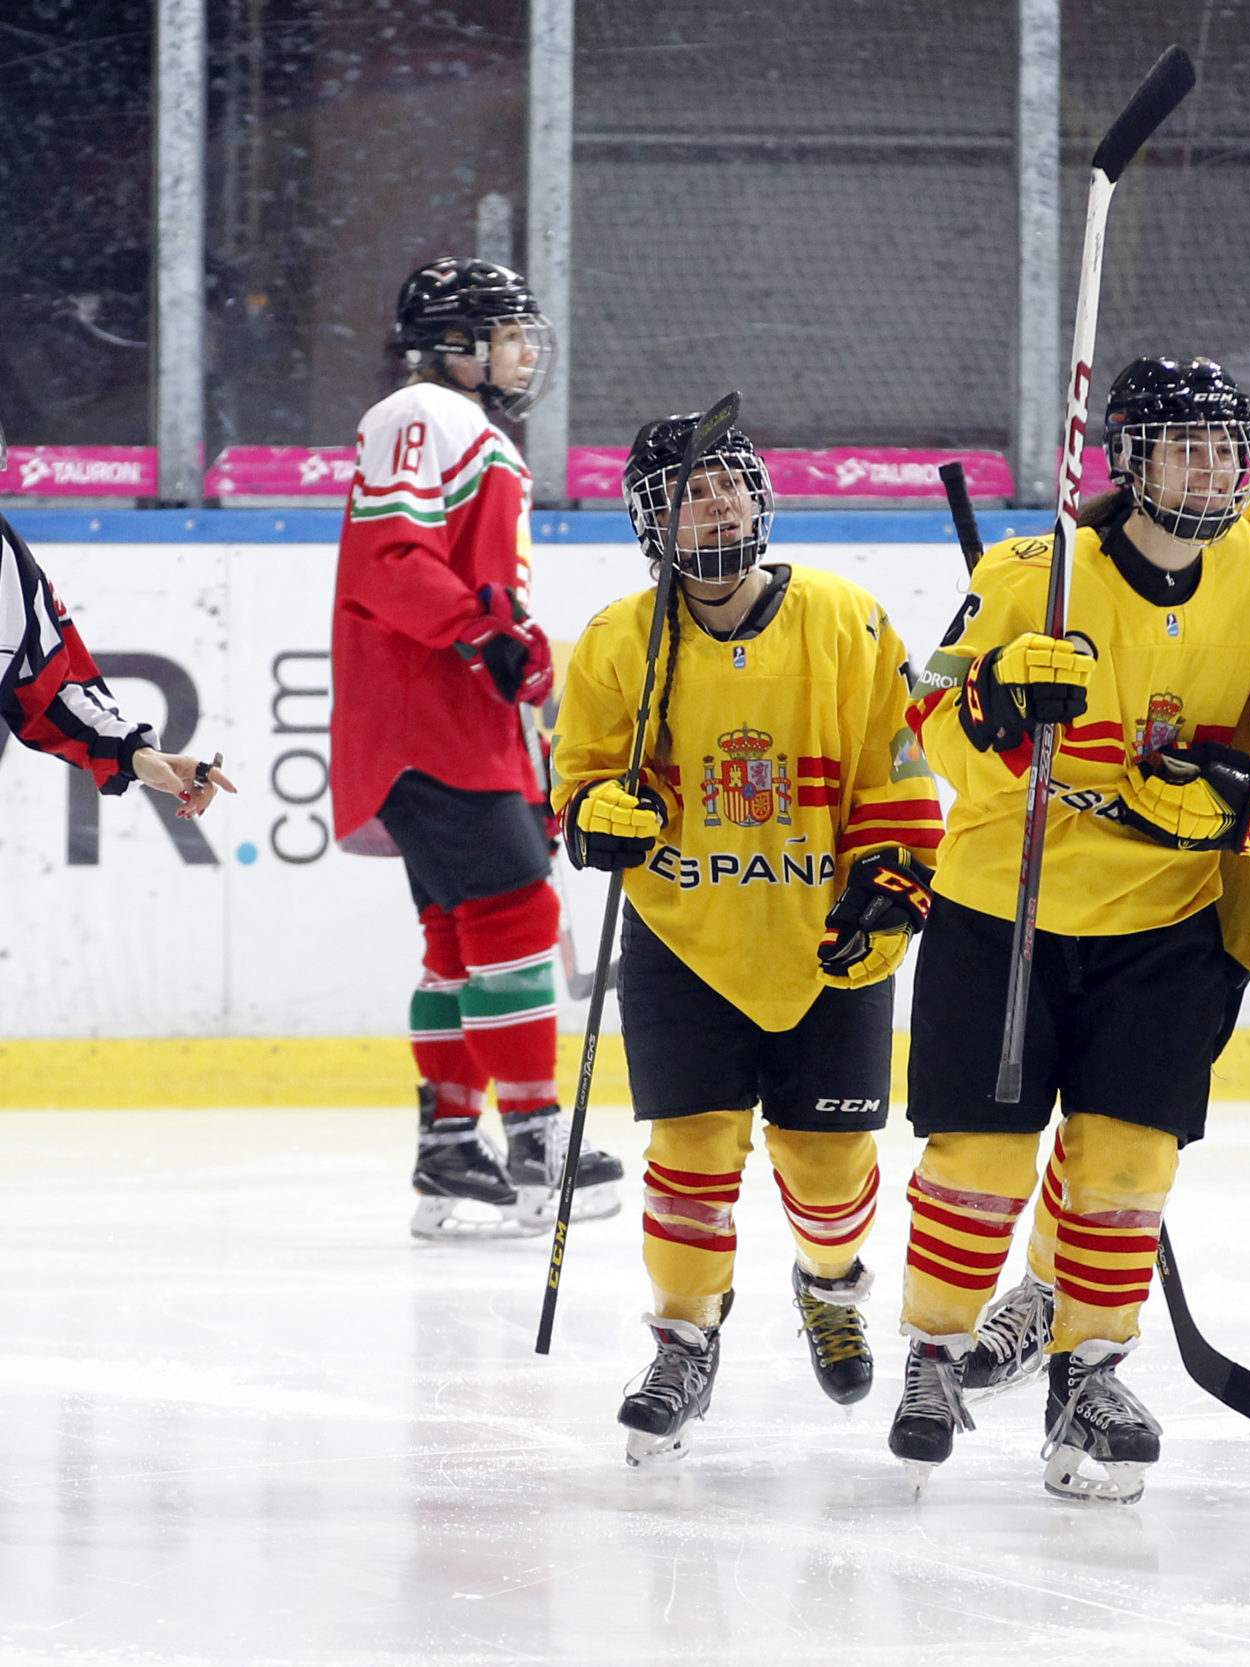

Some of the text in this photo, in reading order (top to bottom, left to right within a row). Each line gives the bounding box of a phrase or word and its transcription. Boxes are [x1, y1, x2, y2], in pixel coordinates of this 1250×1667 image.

[1193, 393, 1233, 402] CCM
[391, 421, 426, 475] 18
[54, 461, 140, 484] TAURON
[870, 463, 972, 484] TAURO
[271, 650, 330, 864] com
[648, 836, 836, 889] ESPAÑA
[815, 1098, 881, 1112] CCM
[548, 1221, 568, 1290] CCM
